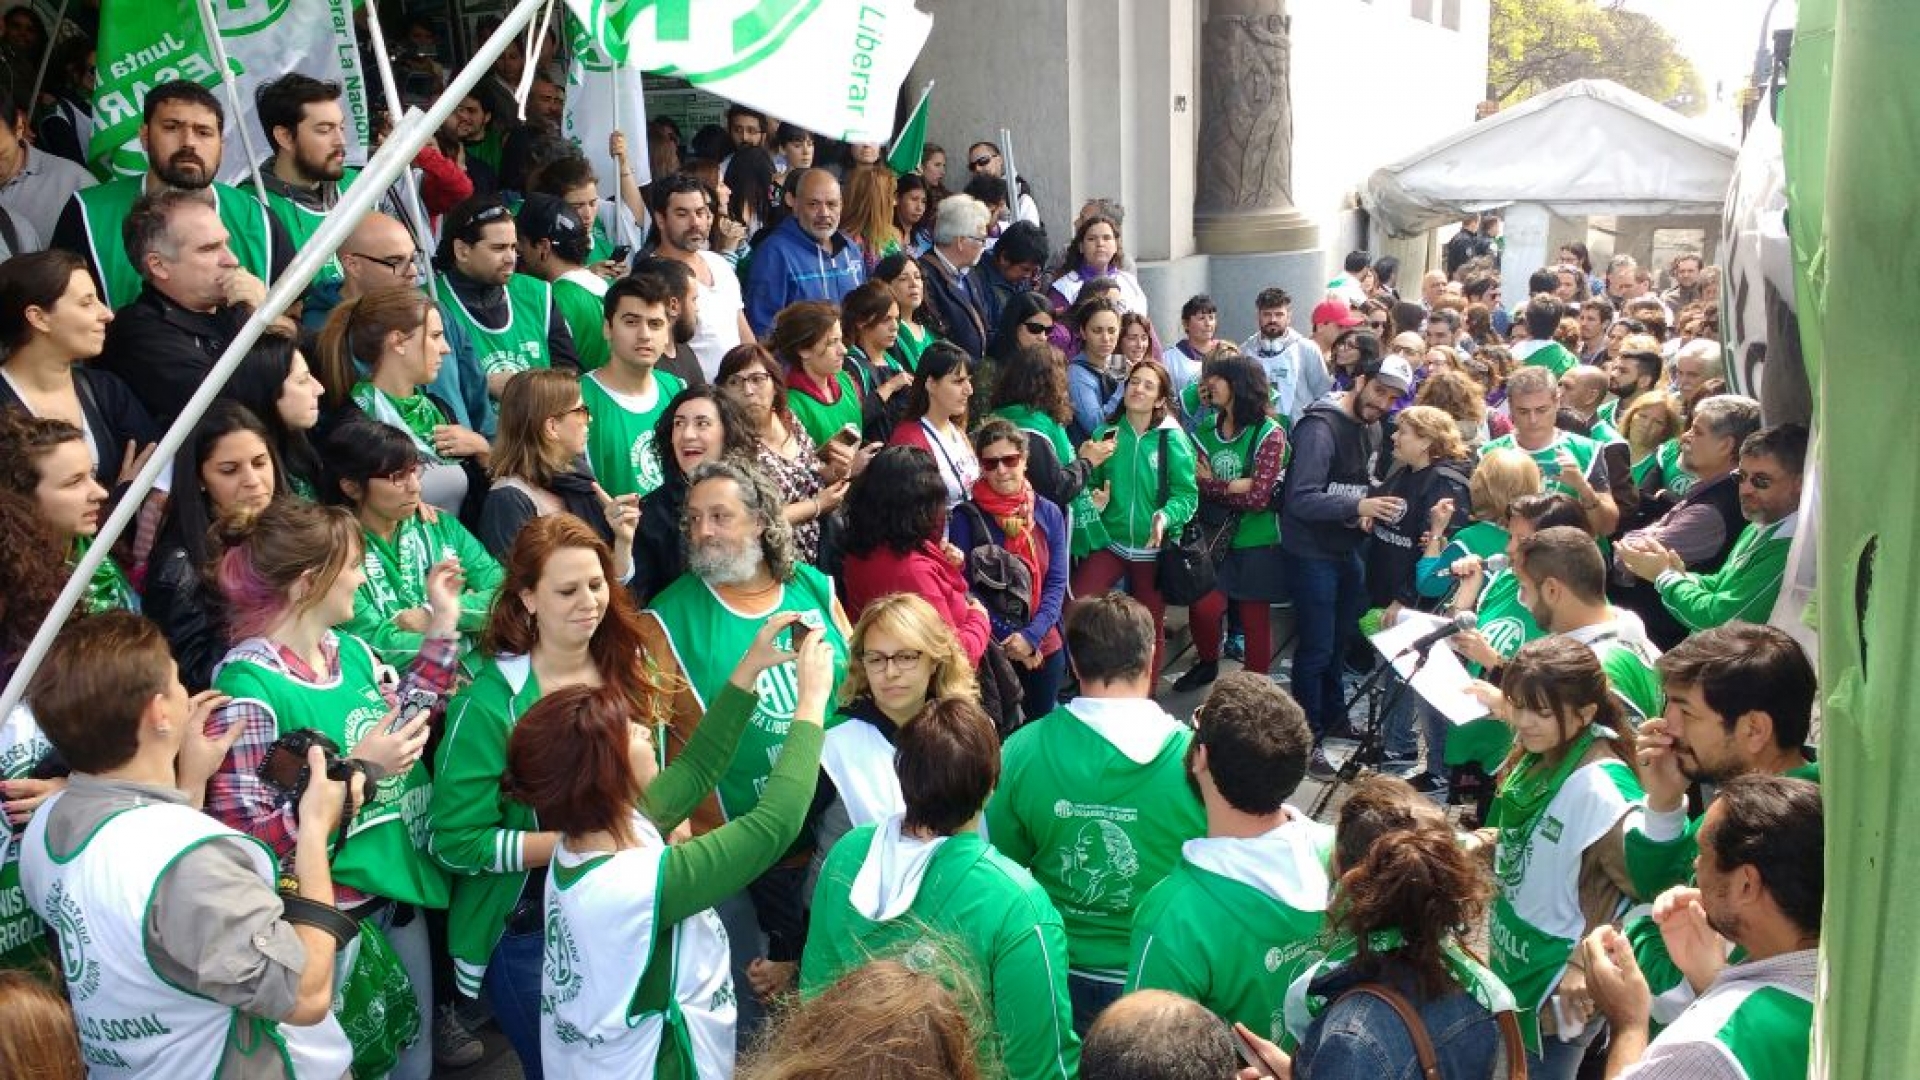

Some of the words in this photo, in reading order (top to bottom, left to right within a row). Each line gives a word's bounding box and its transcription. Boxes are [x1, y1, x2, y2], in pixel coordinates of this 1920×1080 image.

[338, 43, 354, 69] La
[846, 5, 887, 118] Liberar
[101, 1013, 171, 1042] SOCIAL
